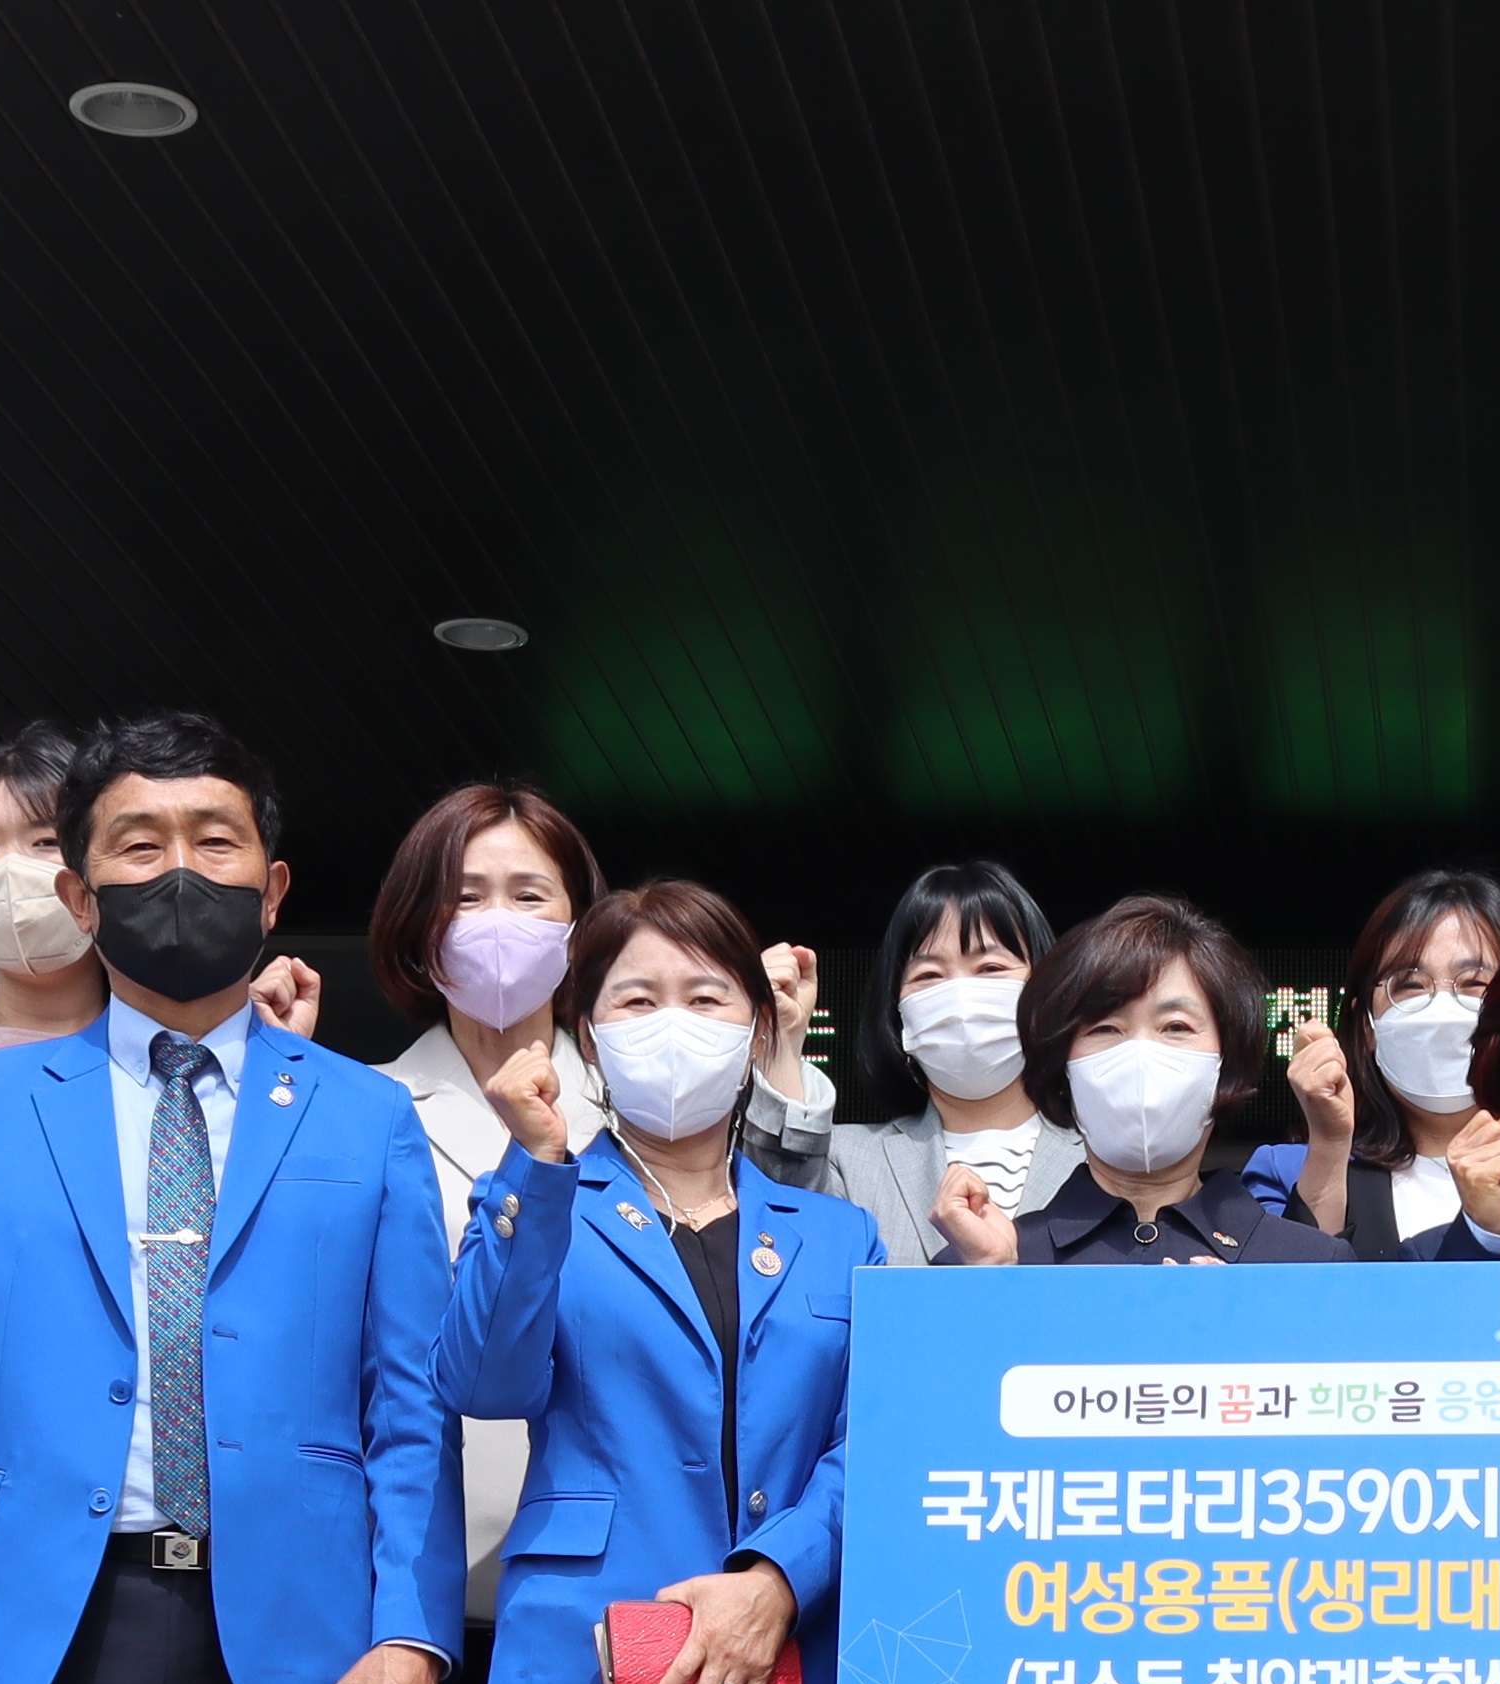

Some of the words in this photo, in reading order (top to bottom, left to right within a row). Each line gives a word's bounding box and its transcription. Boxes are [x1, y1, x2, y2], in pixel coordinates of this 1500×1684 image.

[1050, 1382, 1210, 1428] 아이들의
[1215, 1383, 1300, 1427] 꿈과
[1304, 1379, 1428, 1427] 희망을
